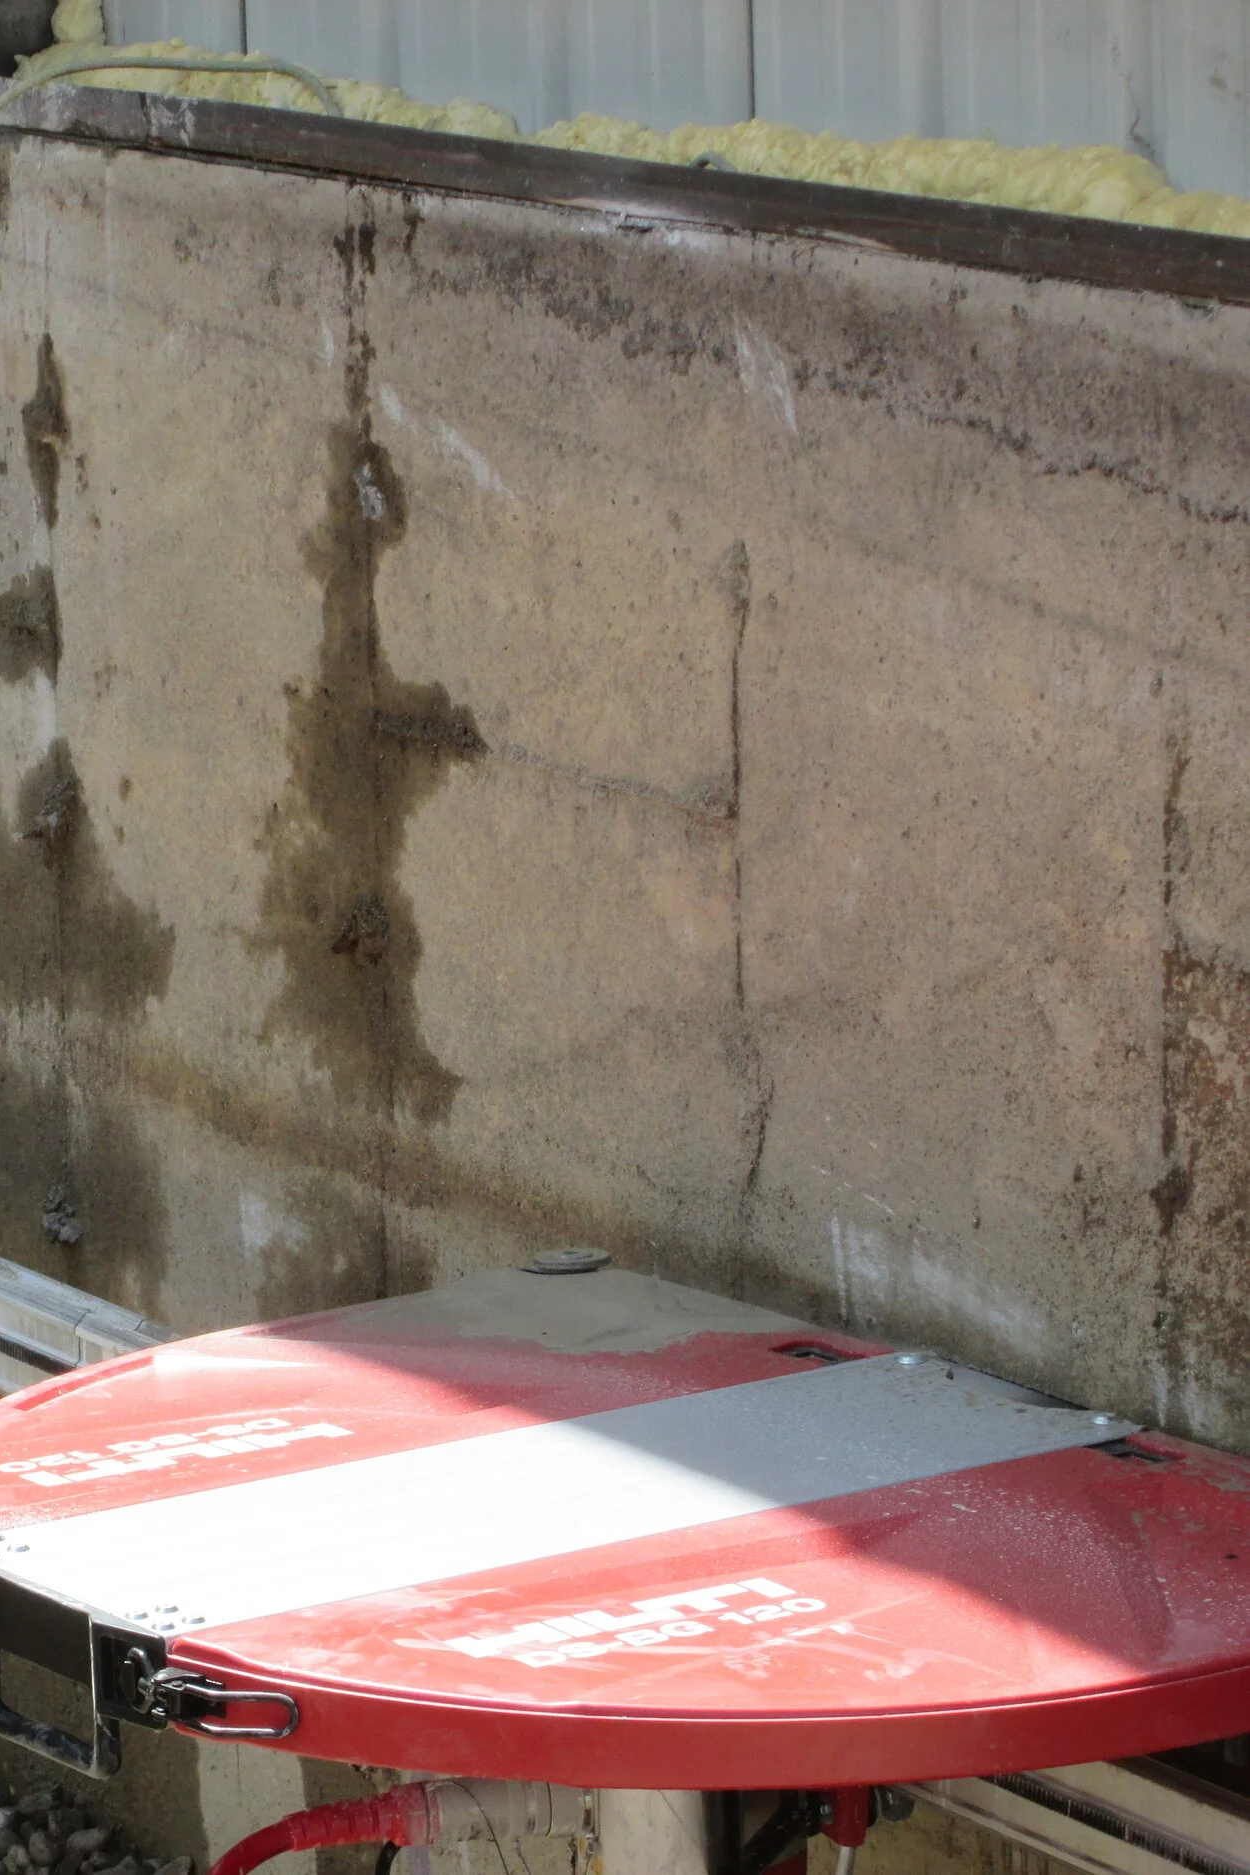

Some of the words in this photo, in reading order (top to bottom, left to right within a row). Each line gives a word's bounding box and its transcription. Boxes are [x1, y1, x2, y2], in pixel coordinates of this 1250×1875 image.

[19, 1422, 354, 1487] HILTI
[443, 1577, 797, 1659] HILTI
[513, 1620, 716, 1668] DS-BG
[718, 1597, 827, 1625] 120
